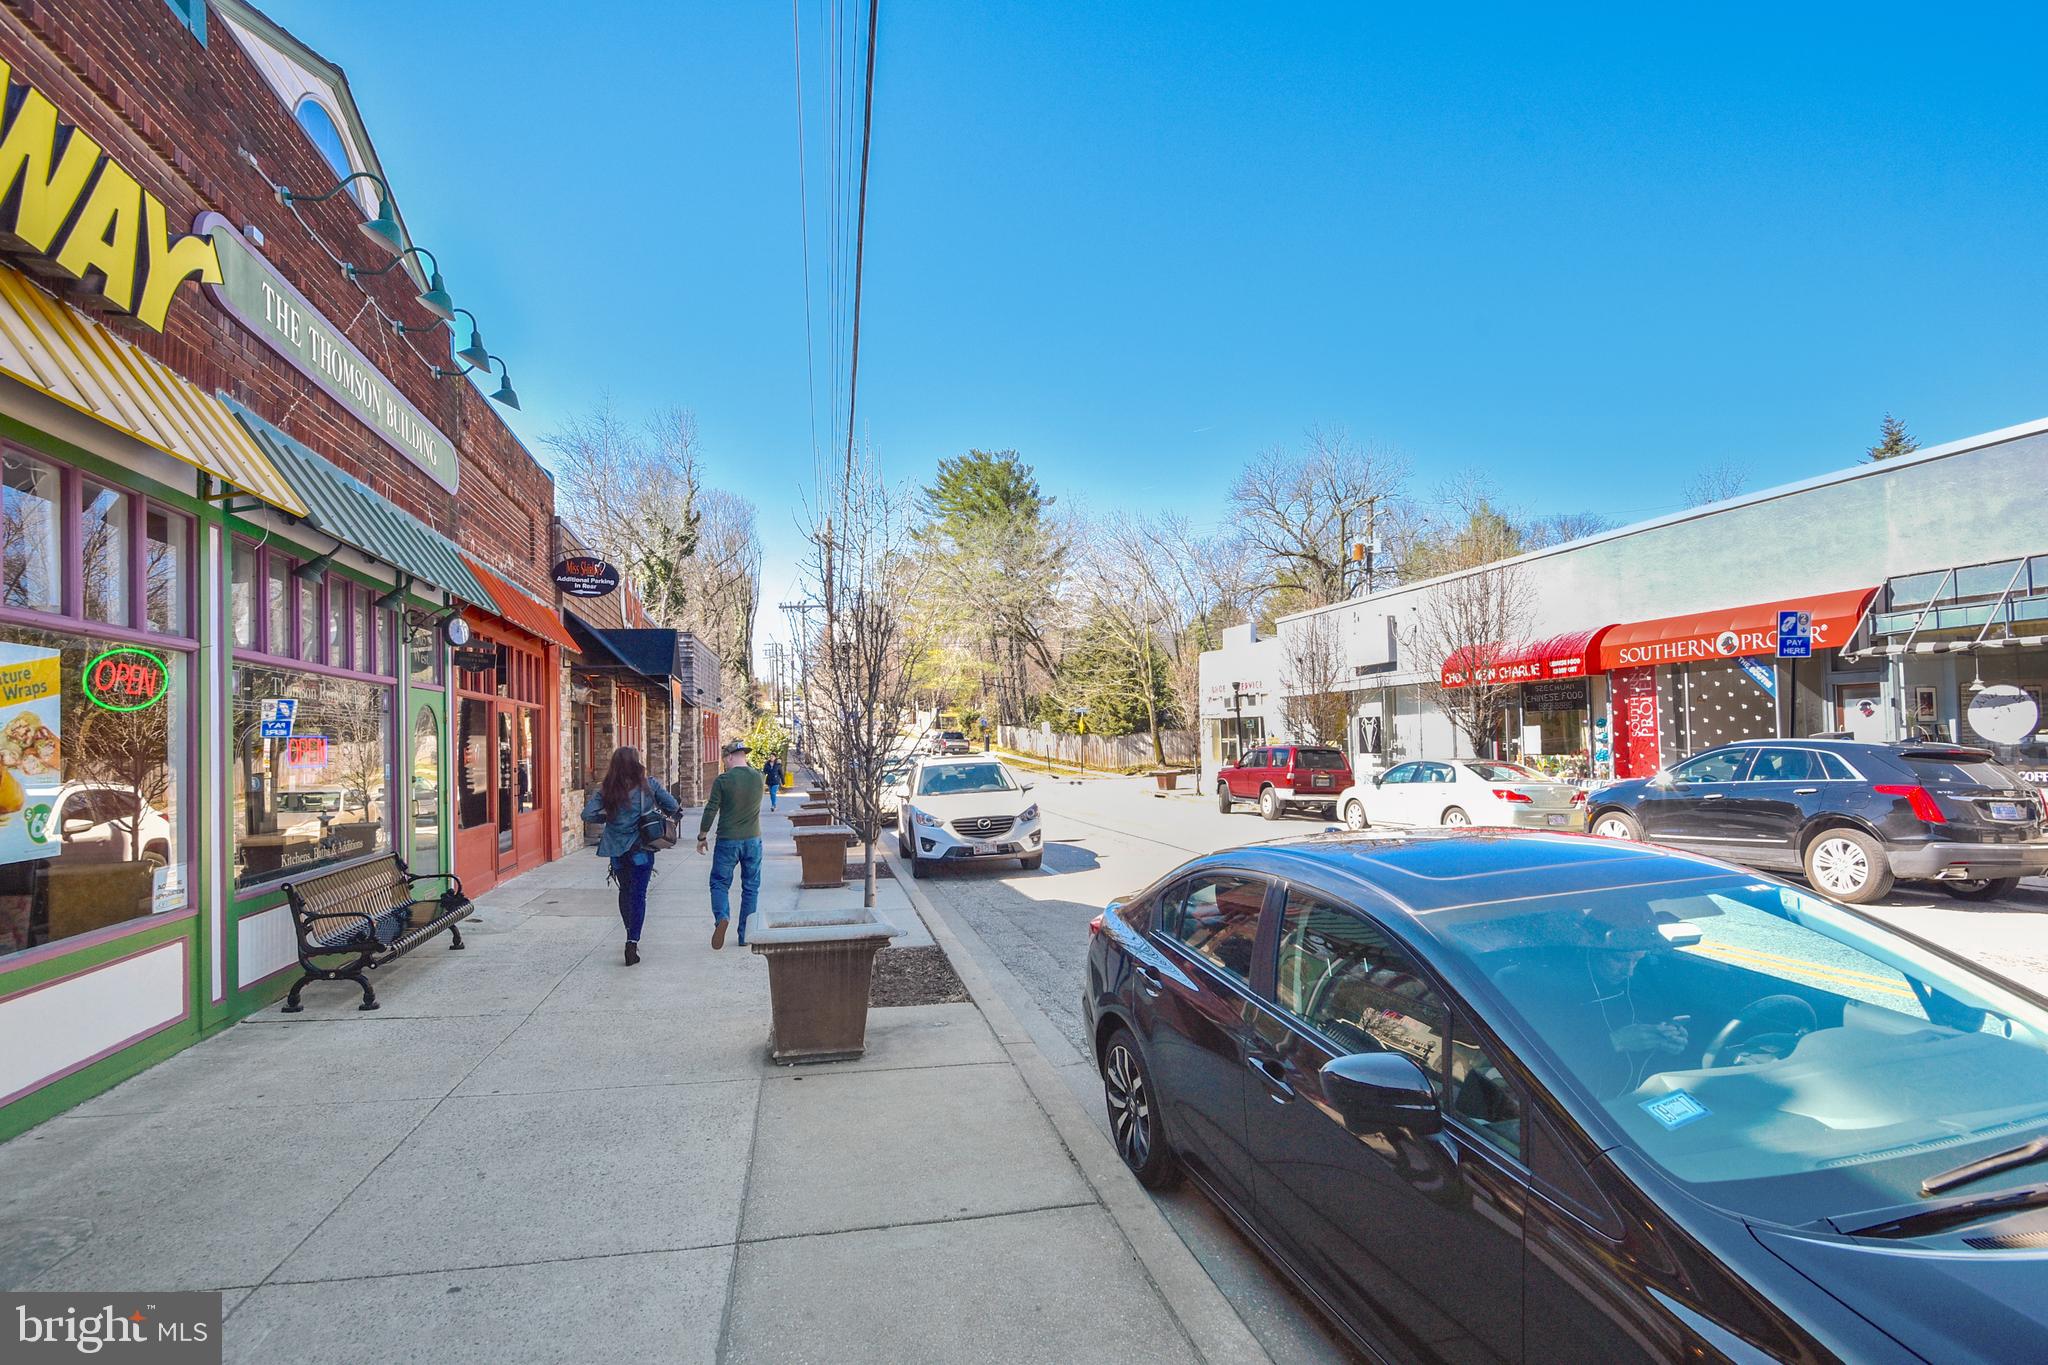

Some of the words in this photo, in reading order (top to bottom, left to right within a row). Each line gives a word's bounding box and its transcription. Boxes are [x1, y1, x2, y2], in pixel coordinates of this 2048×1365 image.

[262, 282, 302, 347] THE
[309, 326, 382, 416] THOMSON
[386, 398, 437, 466] BUILDING
[590, 577, 615, 586] Parking
[1619, 638, 1715, 664] SOUTHERN
[1741, 625, 1827, 650] PROR
[0, 669, 31, 685] ture
[95, 660, 157, 697] OPEN
[1500, 663, 1540, 679] CHARLIE
[3, 682, 47, 700] Wraps
[271, 677, 317, 700] Thomson
[1526, 693, 1560, 702] CHINESE
[1561, 691, 1584, 700] FOOD
[288, 738, 327, 766] OPEN
